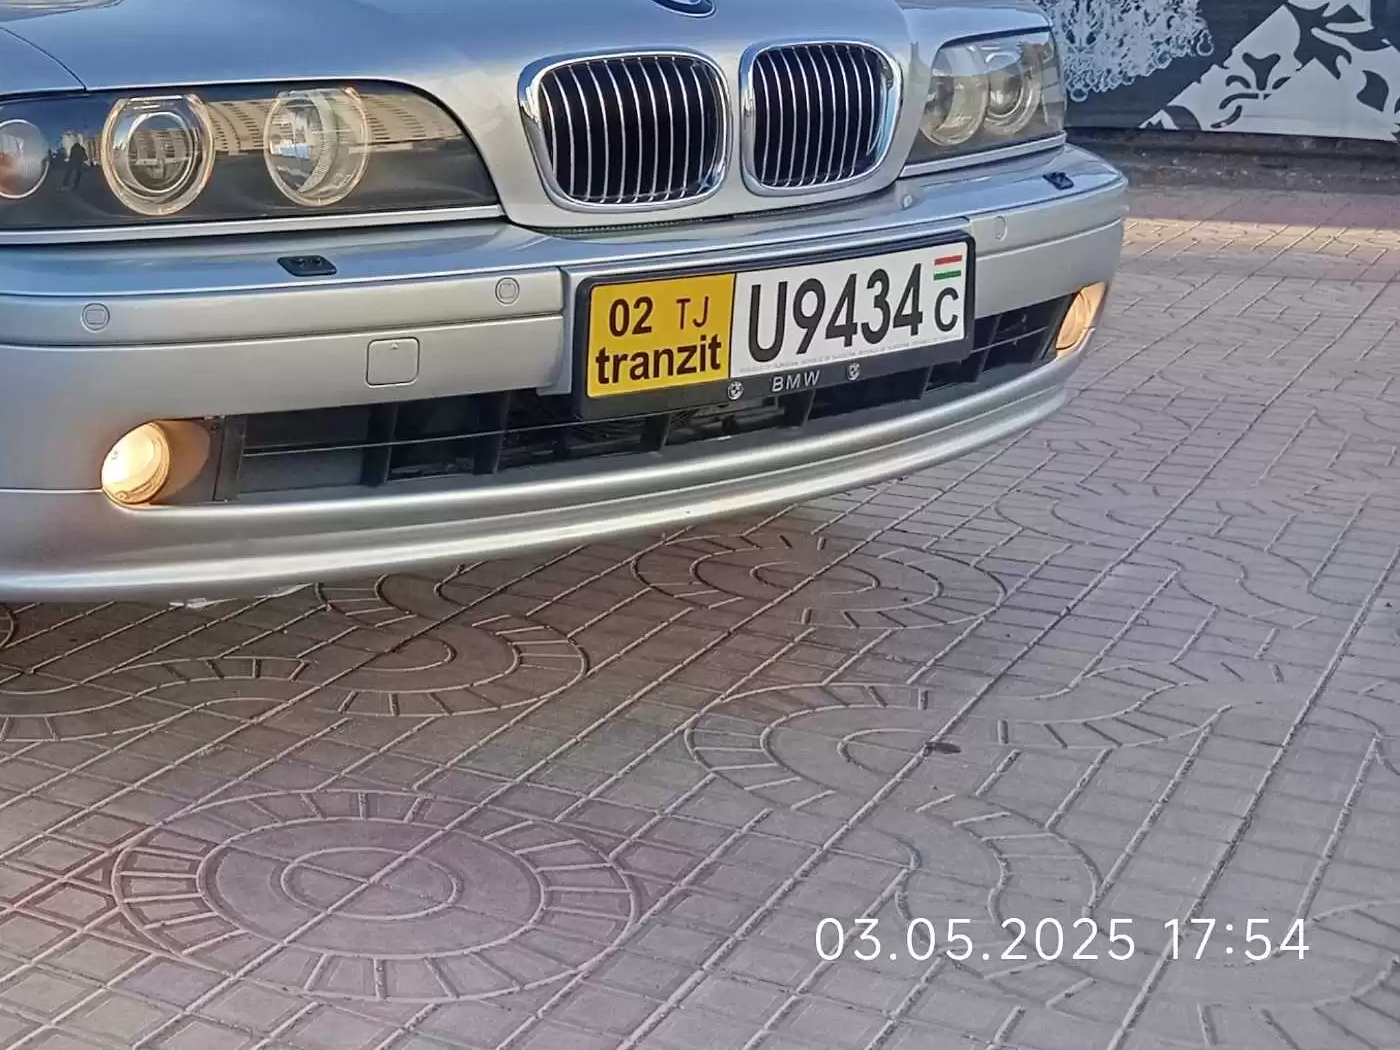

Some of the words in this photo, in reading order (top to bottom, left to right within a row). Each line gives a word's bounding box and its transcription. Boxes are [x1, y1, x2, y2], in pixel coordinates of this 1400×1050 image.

[608, 295, 654, 338] 02
[675, 294, 711, 332] TJ
[748, 262, 923, 363] U9434
[934, 285, 960, 333] C
[595, 334, 722, 385] tranzit
[772, 369, 820, 392] BMW
